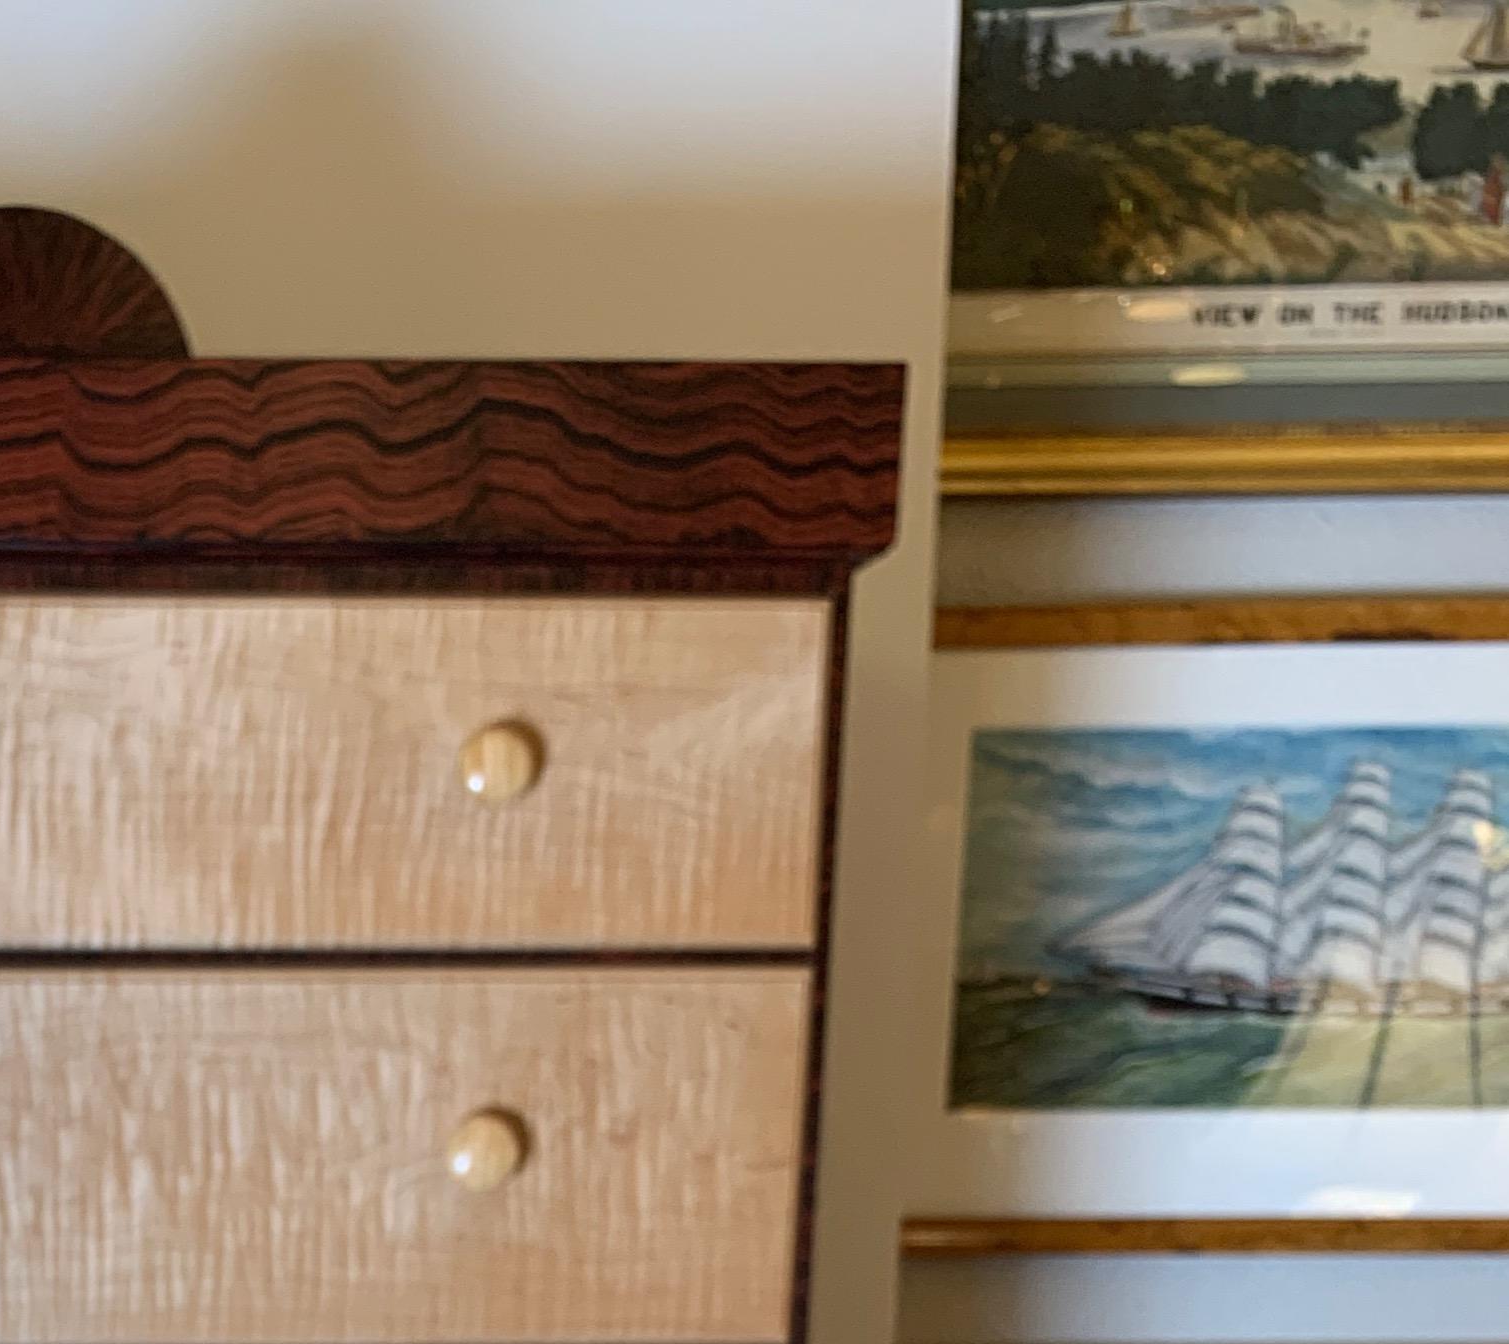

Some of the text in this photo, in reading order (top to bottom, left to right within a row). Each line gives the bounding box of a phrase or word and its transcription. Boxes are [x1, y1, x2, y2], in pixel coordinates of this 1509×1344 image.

[1192, 302, 1260, 326] VIEW
[1276, 302, 1315, 326] ON
[1332, 302, 1382, 325] THE
